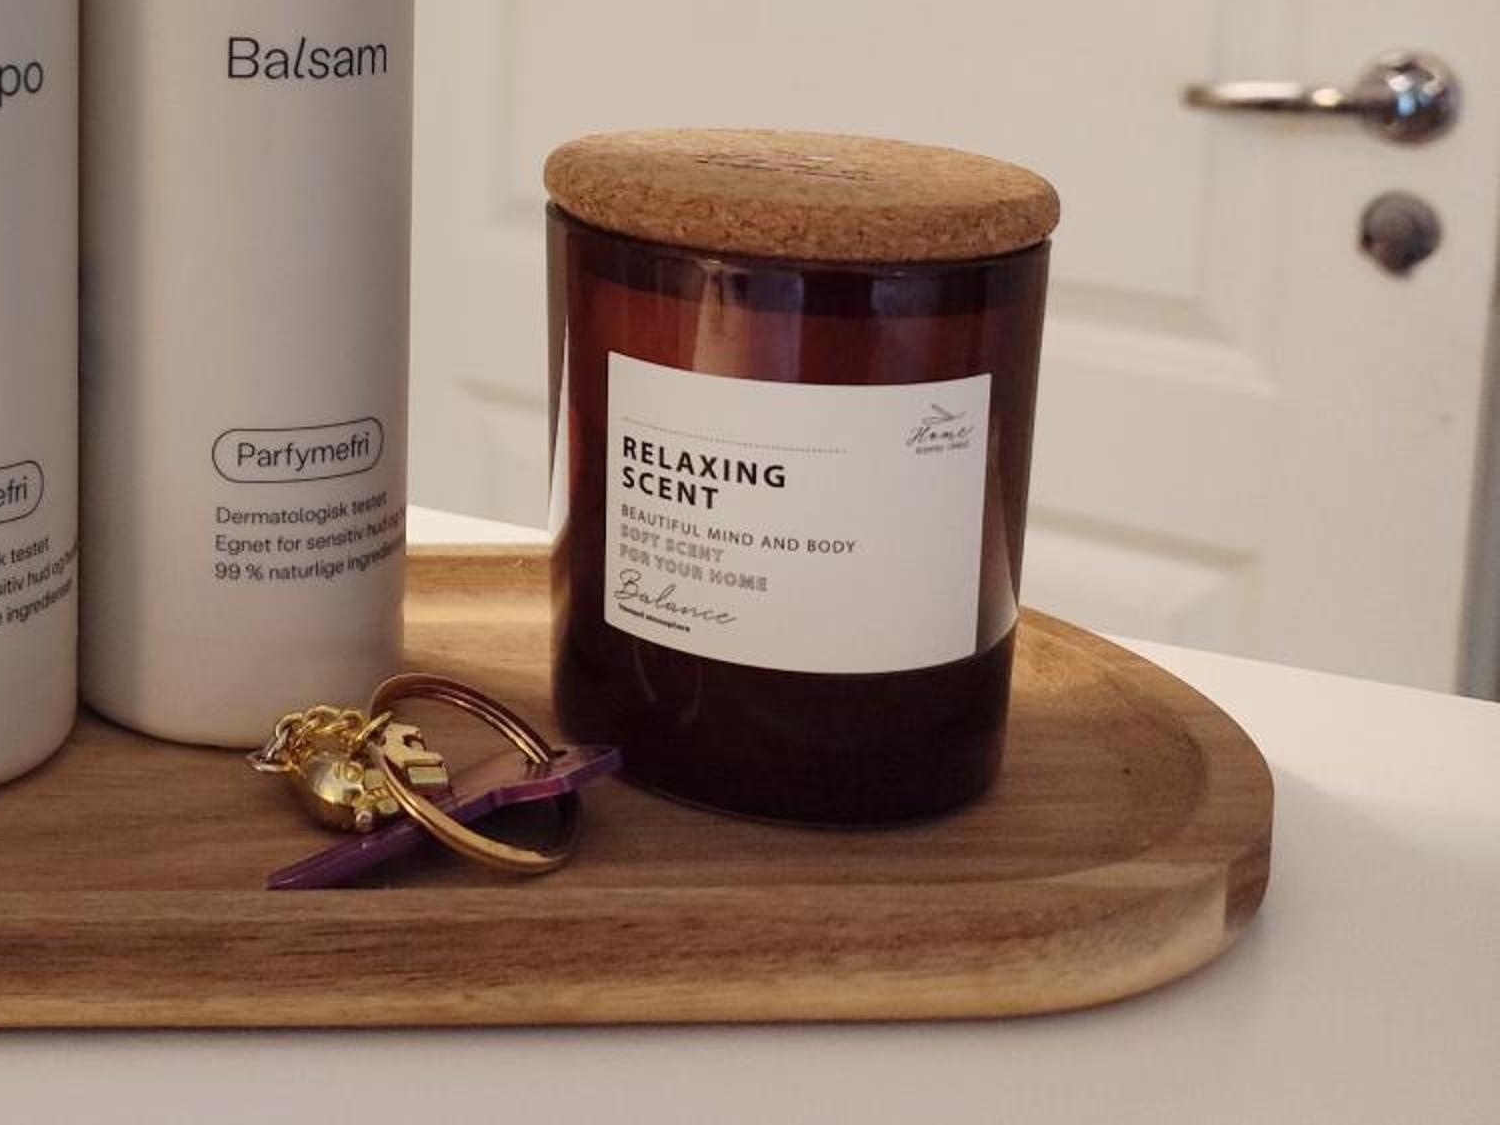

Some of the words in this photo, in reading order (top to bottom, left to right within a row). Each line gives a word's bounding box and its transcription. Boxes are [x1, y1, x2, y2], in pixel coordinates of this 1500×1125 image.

[227, 36, 388, 80] Balsam
[237, 431, 371, 472] Parfymefri
[623, 436, 786, 488] RELAXING
[622, 466, 719, 510] SCENT
[216, 501, 348, 526] Dermatologisk
[621, 504, 701, 538] BEAUTIFUL
[707, 528, 754, 546] MIND
[761, 536, 800, 552] AND
[807, 539, 857, 554] BODY
[215, 534, 271, 556] Egnet
[277, 536, 301, 553] for
[666, 538, 726, 564] SCENT
[215, 561, 241, 581] 99
[246, 563, 264, 580] %
[269, 555, 344, 581] naturlige
[619, 543, 651, 568] FOR
[654, 554, 703, 582] YOUR
[709, 568, 768, 592] HOME
[613, 568, 738, 624] Balance
